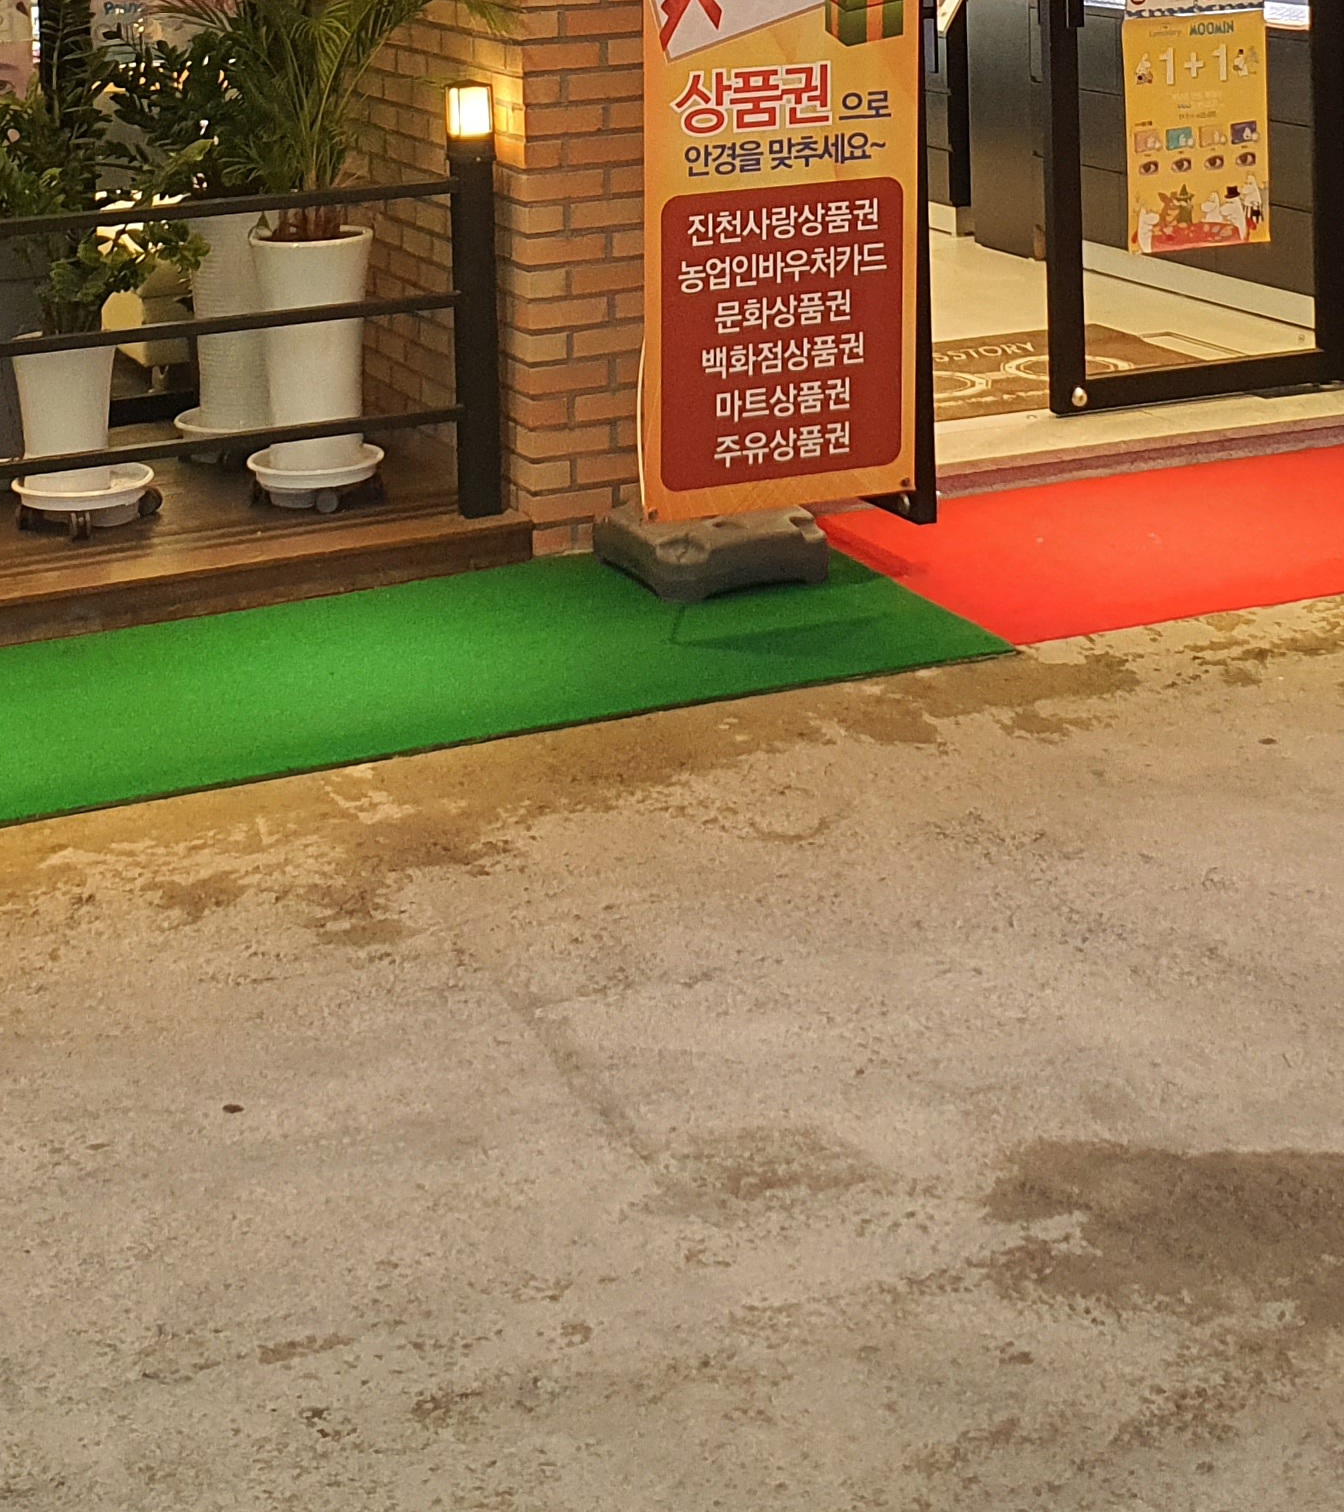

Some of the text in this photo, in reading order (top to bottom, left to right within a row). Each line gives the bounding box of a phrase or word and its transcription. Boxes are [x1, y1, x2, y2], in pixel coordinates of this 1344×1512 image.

[1189, 20, 1235, 36] MOOMIN
[668, 60, 893, 138] 상품권 으로
[683, 140, 764, 178] 안경을
[687, 197, 881, 248] 진천사랑상품권
[677, 241, 888, 294] 농업인바우처카드
[714, 289, 853, 335] 문화상품권
[700, 332, 866, 381] 백화점상품권
[714, 377, 852, 424] 마트상품권
[712, 421, 852, 469] 주유상품권
